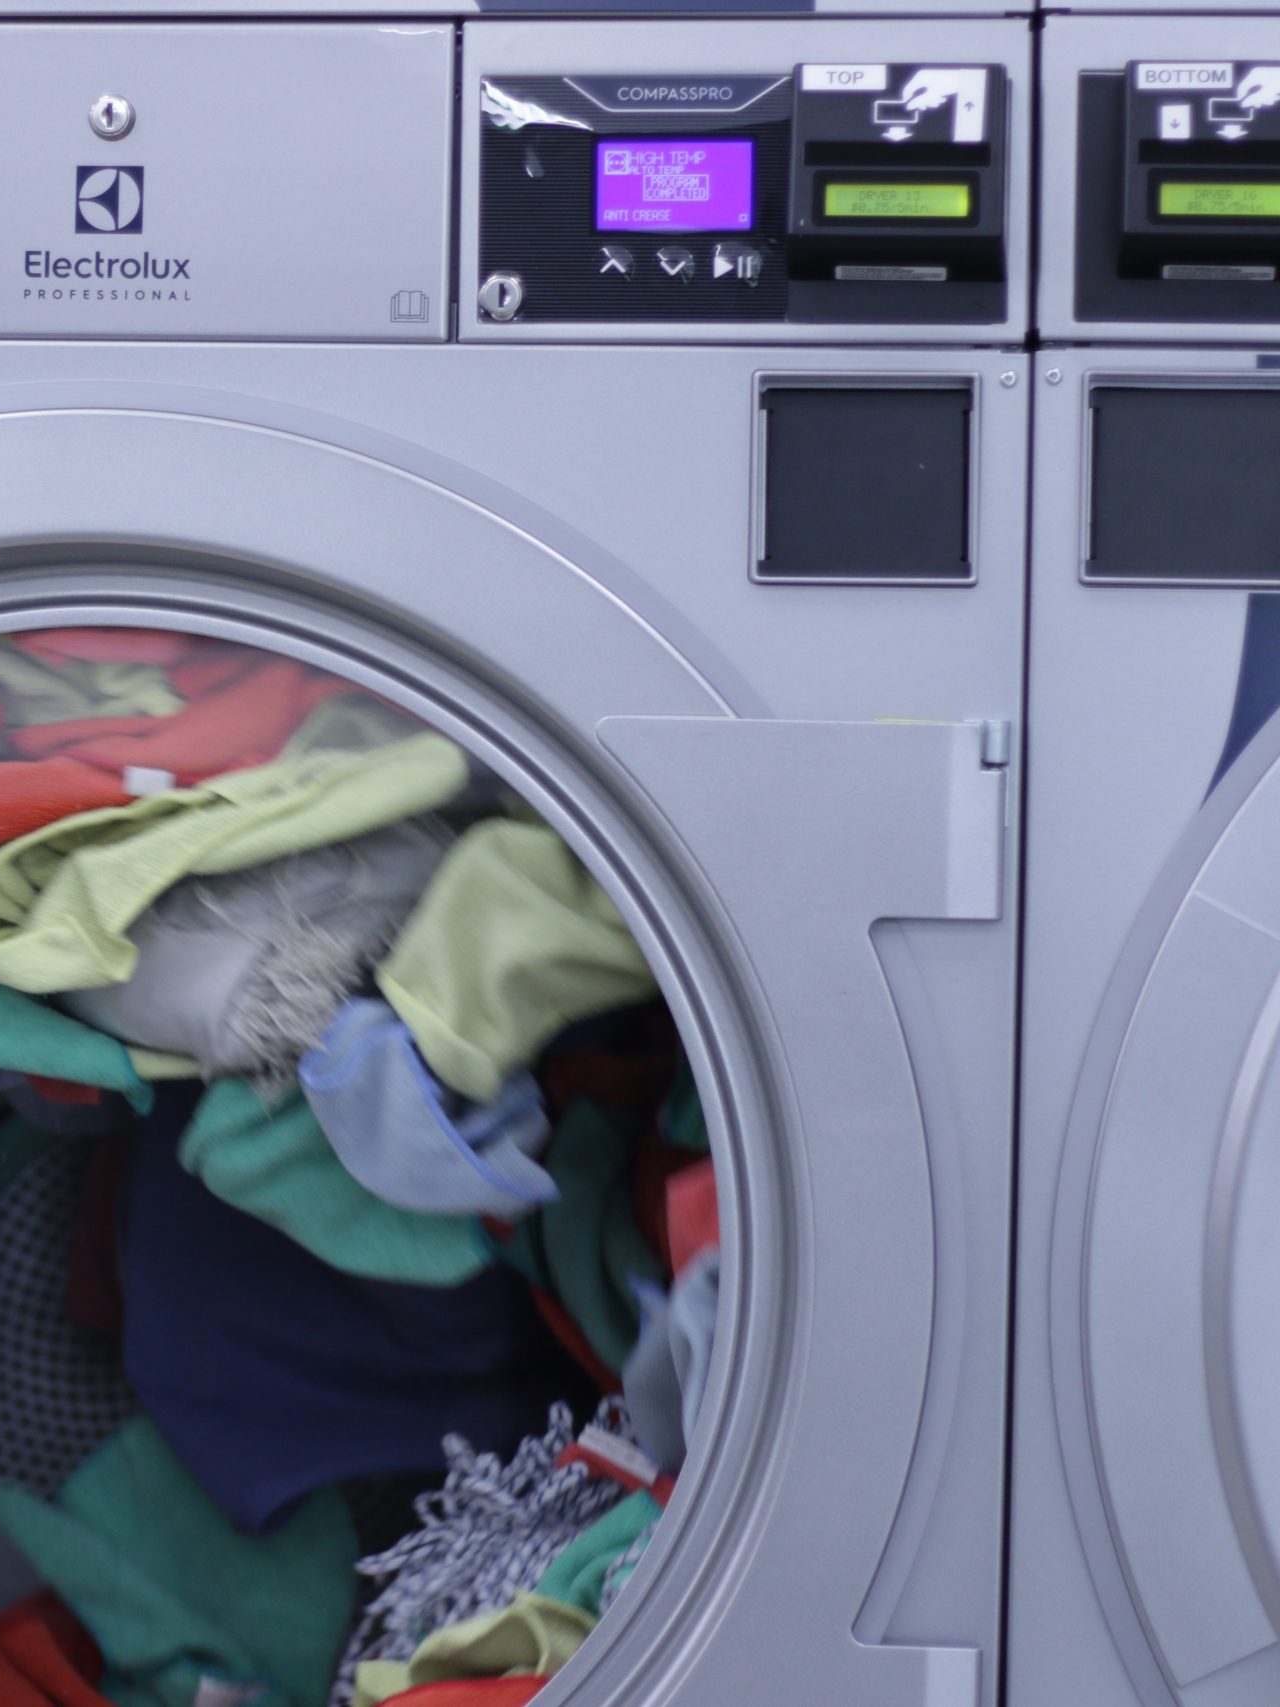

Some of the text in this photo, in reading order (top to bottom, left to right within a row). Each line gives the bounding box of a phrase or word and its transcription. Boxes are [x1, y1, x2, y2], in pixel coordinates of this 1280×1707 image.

[826, 71, 865, 84] TOP
[1145, 69, 1227, 83] BOTTOM
[617, 87, 733, 101] COMPASSPRO
[628, 151, 707, 165] HIGH TEMP
[629, 165, 685, 175] ALTO TEMP
[650, 176, 700, 188] PROGRAM
[646, 187, 706, 200] COMPLETED
[604, 210, 671, 221] ANTI CREASE
[24, 251, 191, 279] Electrolux
[23, 289, 191, 301] PROFESSIONAL
